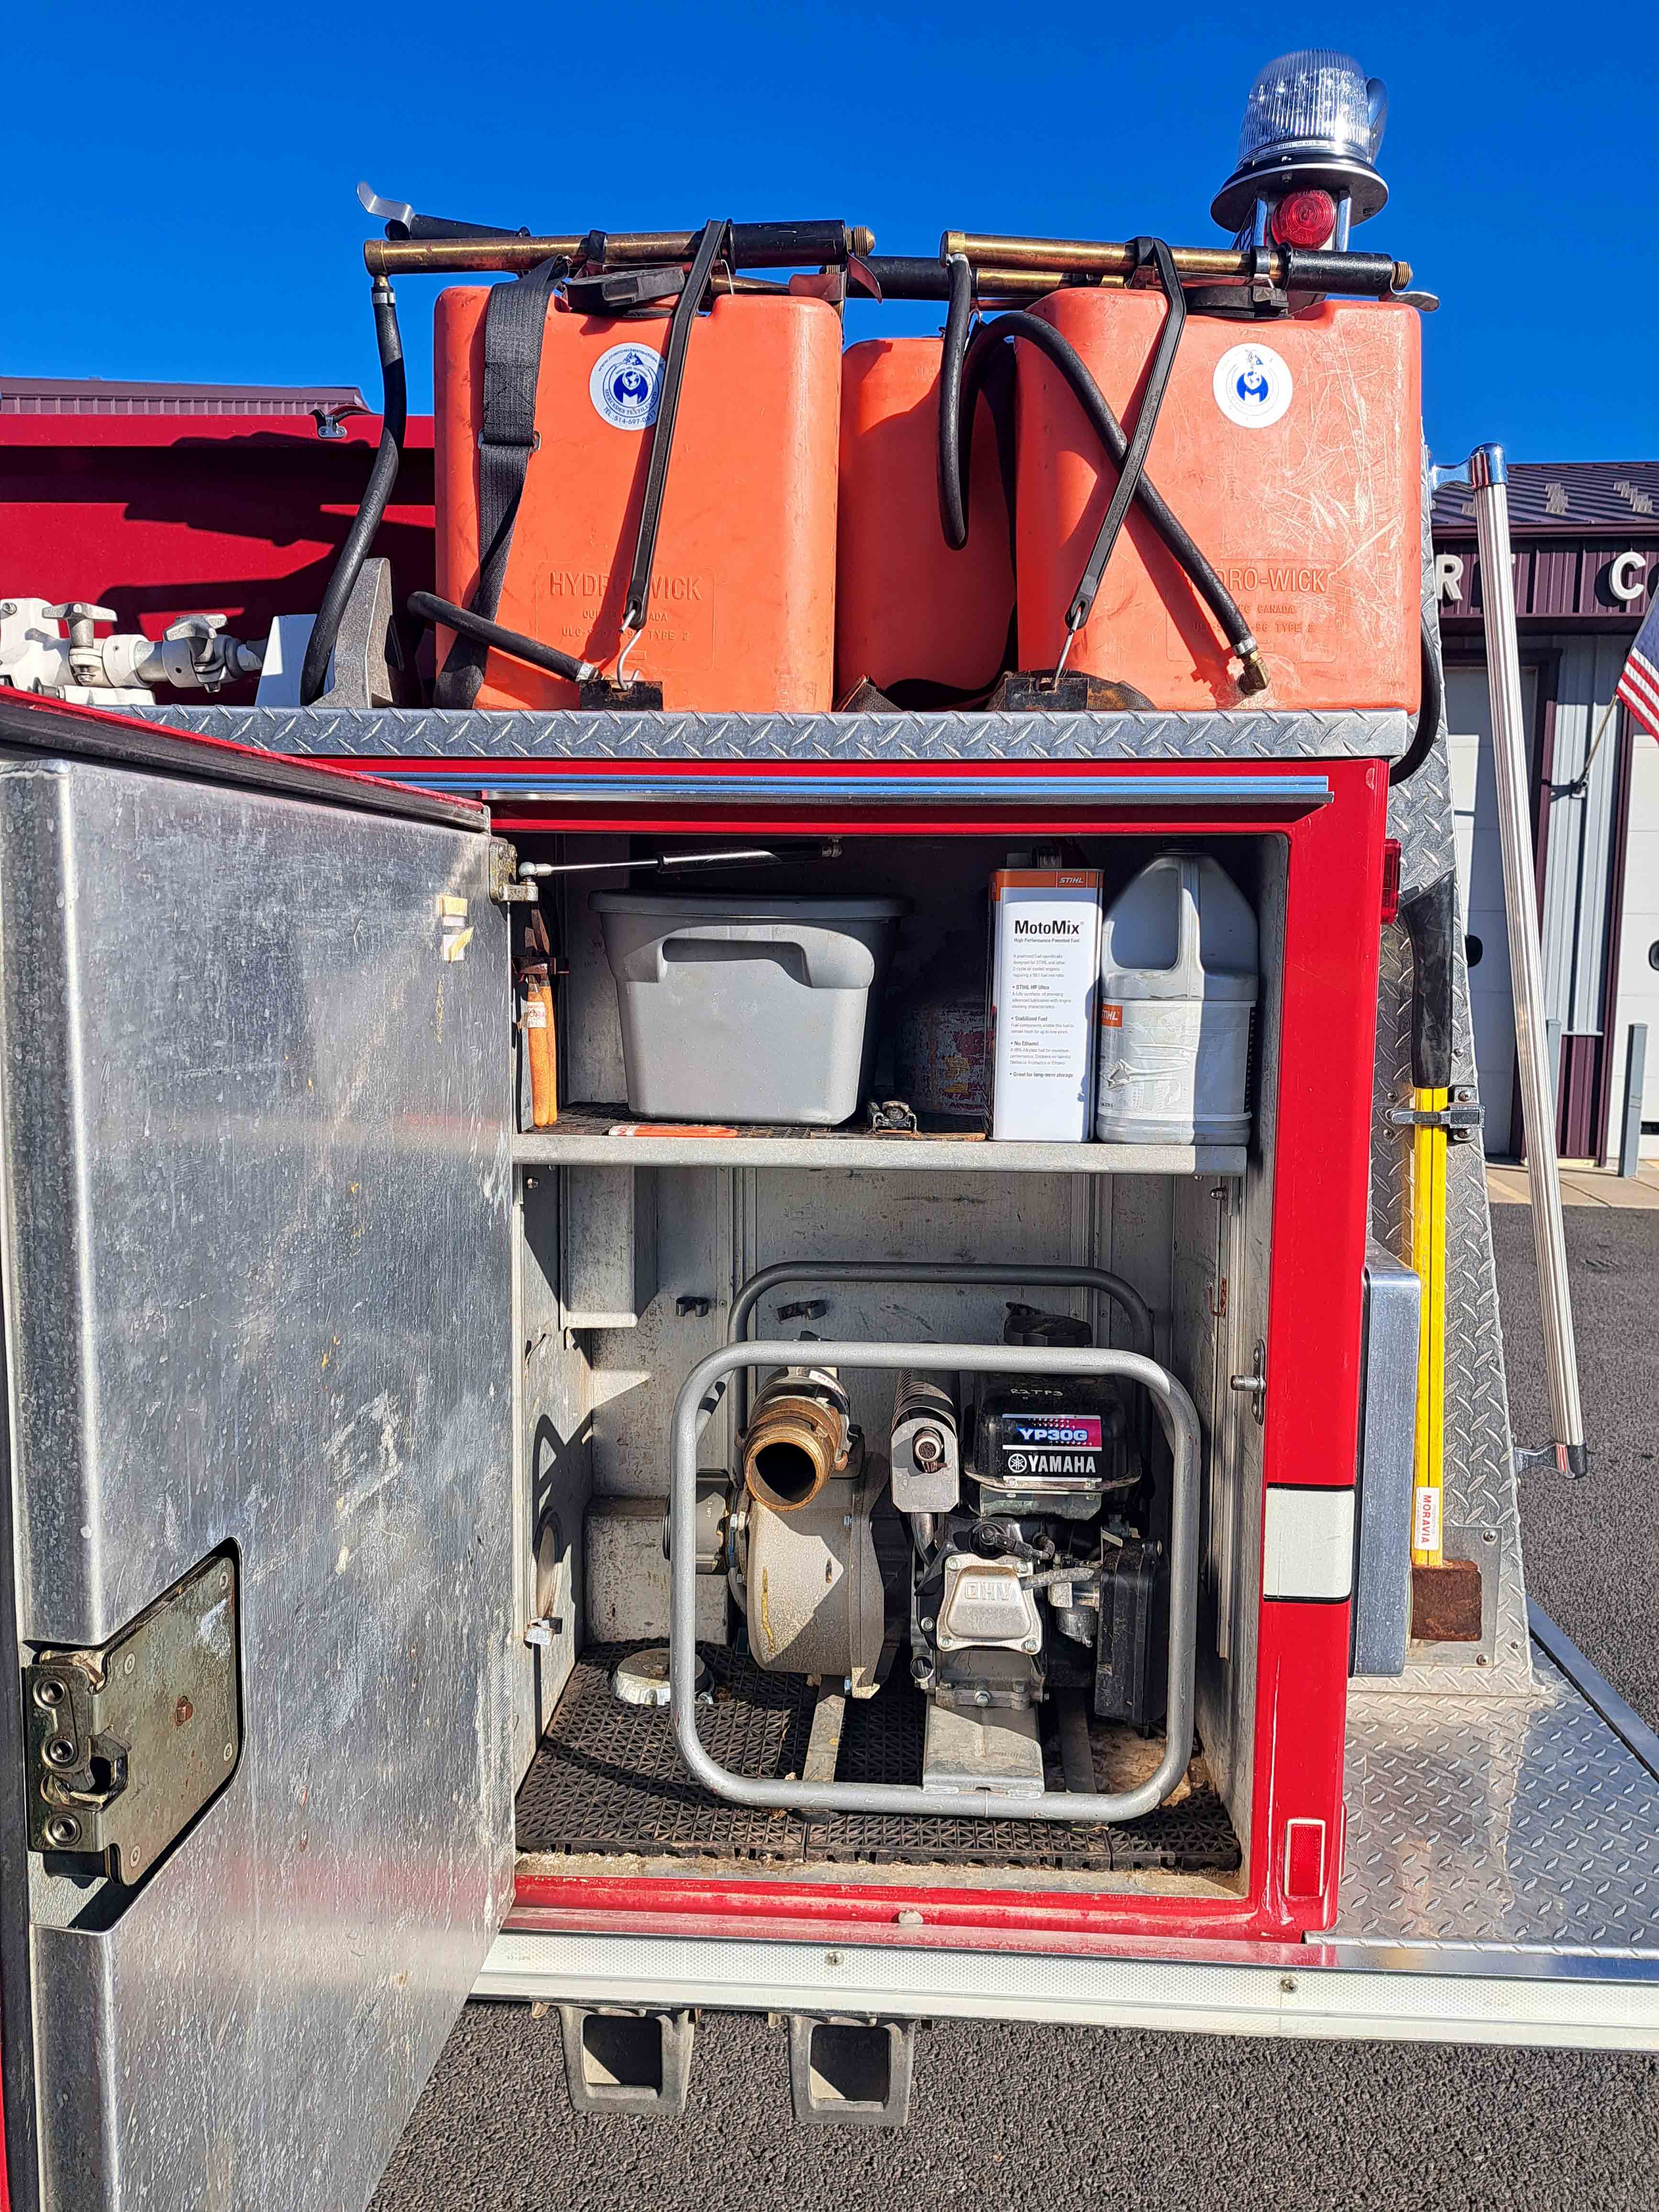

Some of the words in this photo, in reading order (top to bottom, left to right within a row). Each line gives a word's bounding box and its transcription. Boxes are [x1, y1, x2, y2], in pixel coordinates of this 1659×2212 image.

[1216, 568, 1327, 592] DRO-WICK
[1257, 604, 1294, 614] CANADA
[1276, 622, 1302, 632] TYPE
[1308, 623, 1316, 632] 2
[648, 630, 675, 641] TYPE
[682, 631, 689, 641] 2
[1019, 1428, 1088, 1441] YP30G
[1028, 1455, 1096, 1473] YAMAHA
[1421, 1495, 1432, 1543] MORAVIA
[964, 1582, 1013, 1600] OHV
